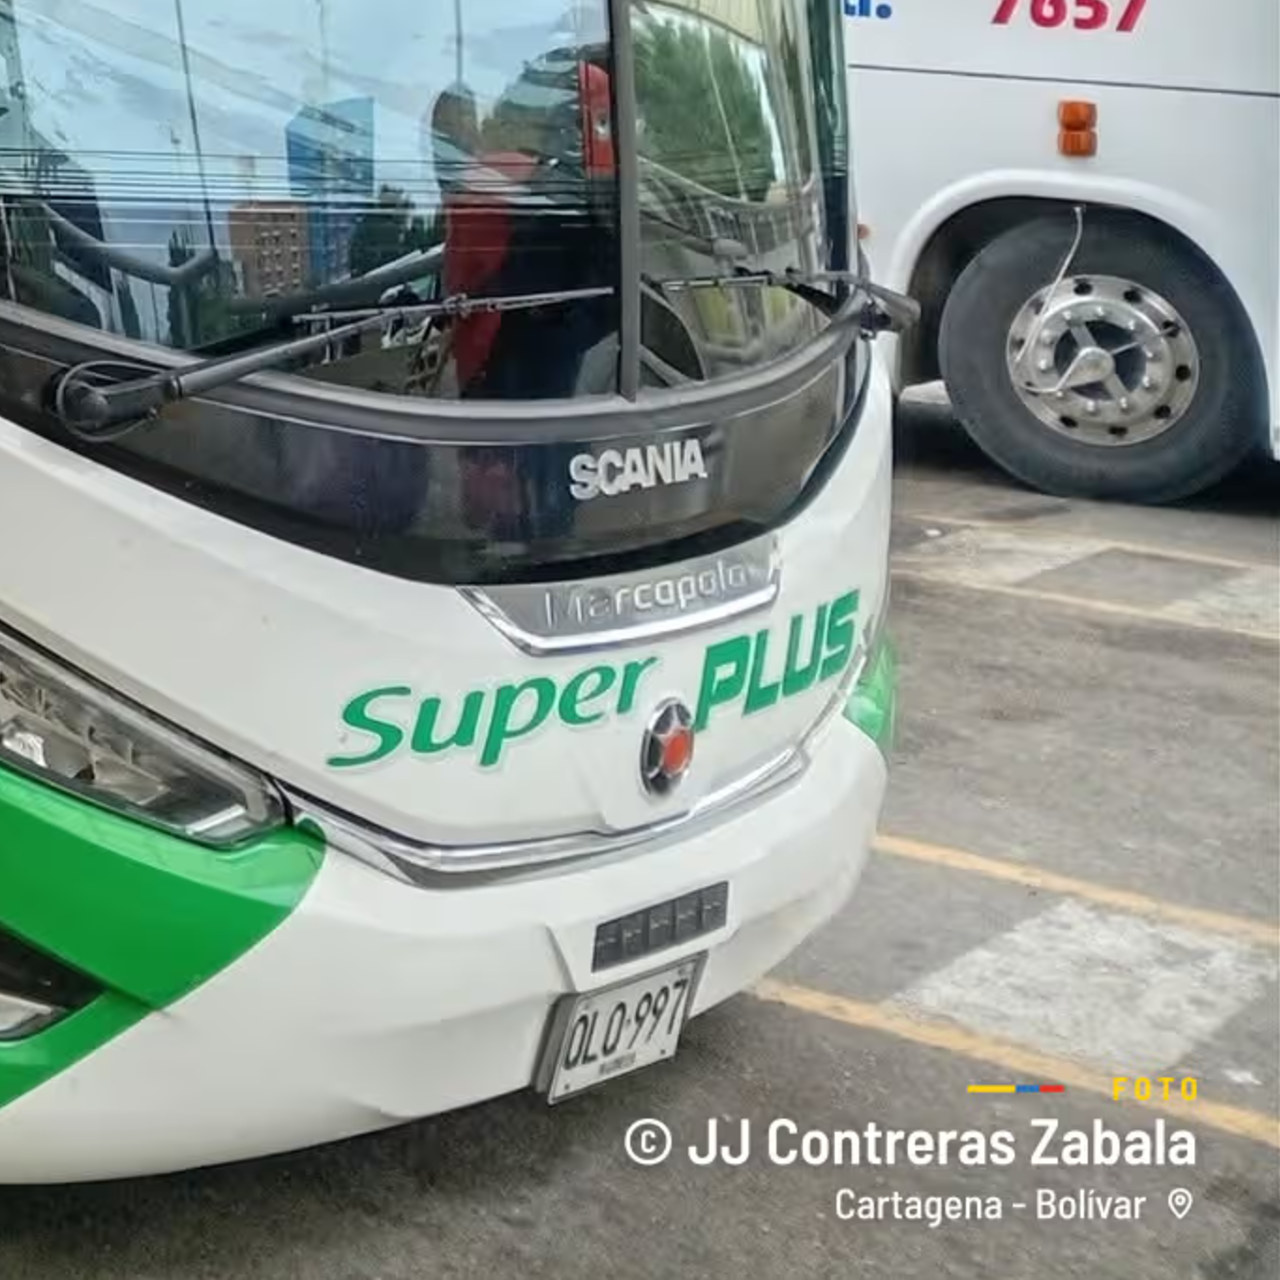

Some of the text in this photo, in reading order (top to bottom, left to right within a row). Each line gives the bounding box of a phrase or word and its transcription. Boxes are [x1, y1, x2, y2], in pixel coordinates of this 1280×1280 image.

[569, 438, 708, 501] SCANIA
[544, 558, 749, 629] Marcopolo
[325, 588, 862, 768] Super PLUS
